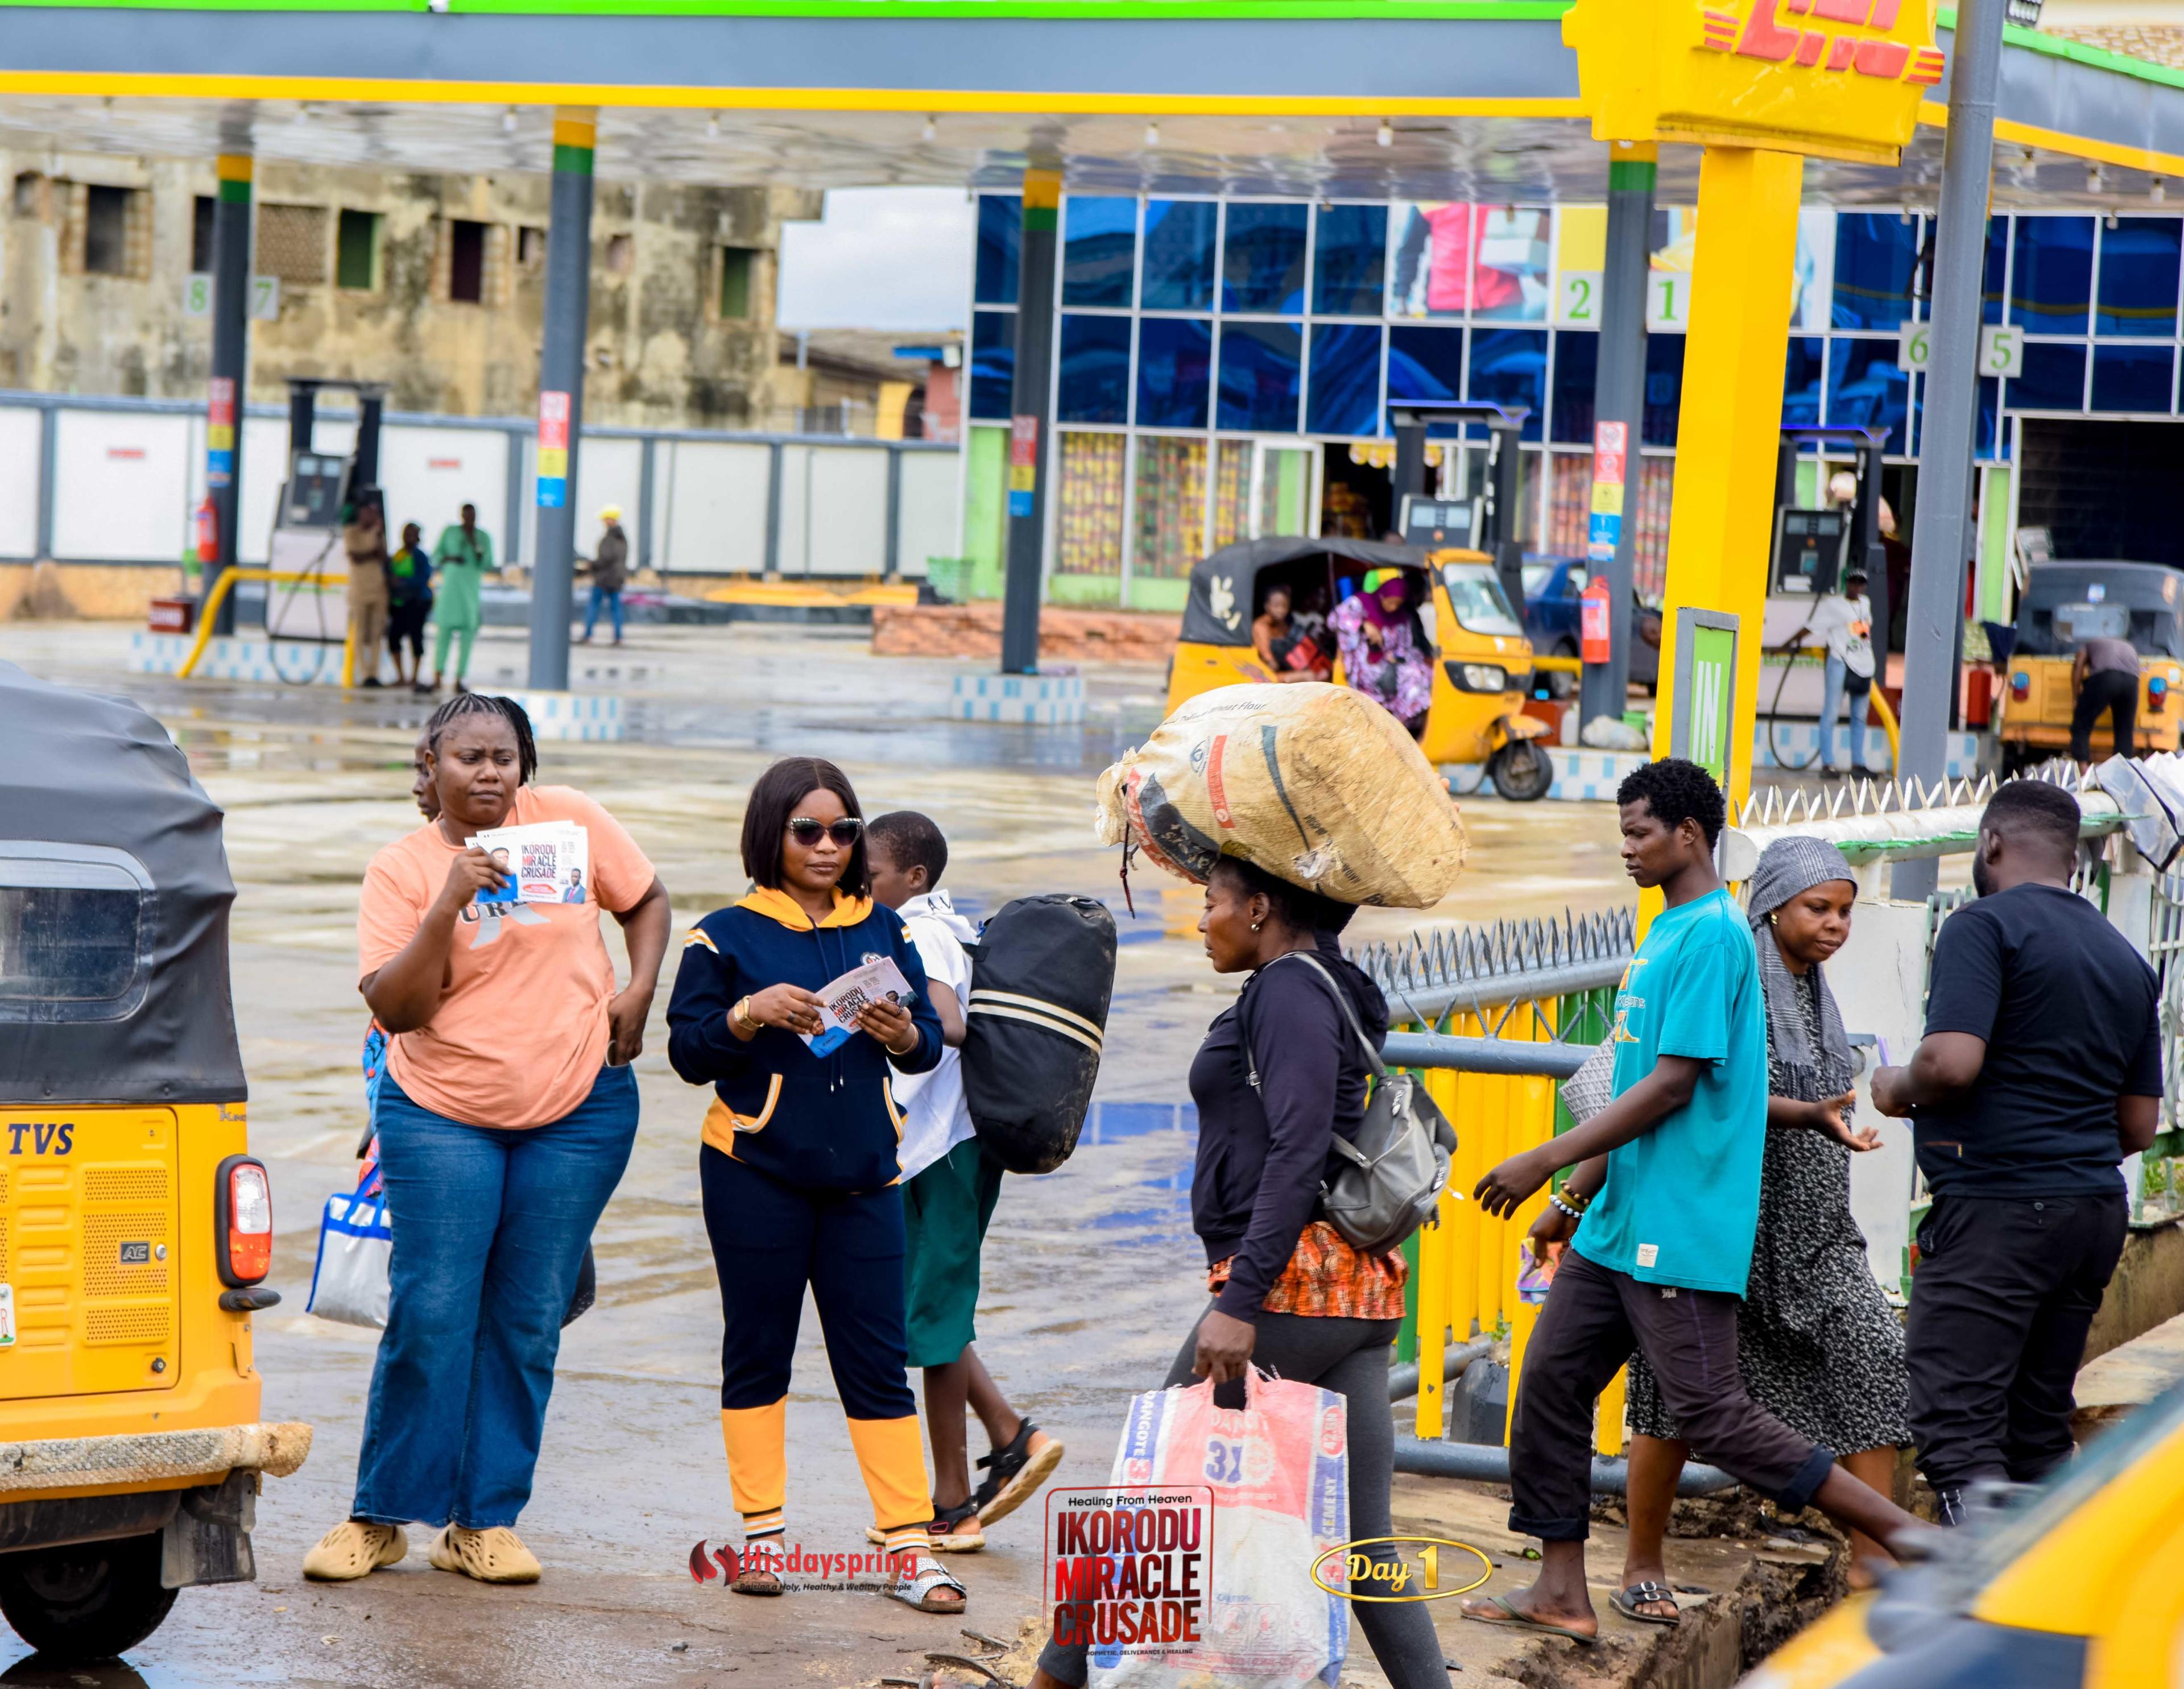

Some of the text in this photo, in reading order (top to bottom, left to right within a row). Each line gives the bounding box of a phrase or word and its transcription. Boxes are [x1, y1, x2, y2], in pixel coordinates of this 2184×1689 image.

[191, 279, 206, 311] 8
[255, 281, 272, 312] 7
[1568, 279, 1591, 320] 2
[1657, 279, 1677, 321] 1
[1909, 328, 1928, 364] 6
[1991, 333, 2012, 370] 5
[1238, 701, 1268, 711] Flour
[1691, 660, 1722, 764] IN
[521, 843, 556, 855] IKORODU
[522, 855, 556, 867] MIRACLE
[521, 867, 556, 879] CRUSADE
[829, 986, 863, 1012] IKORODU
[834, 993, 868, 1017] MIRACLE
[838, 1000, 870, 1023] CRUSA
[8, 1123, 75, 1156] TVS
[122, 1246, 147, 1260] AC
[1133, 1391, 1156, 1456] DANGOTE
[1322, 1477, 1337, 1537] CEMENT
